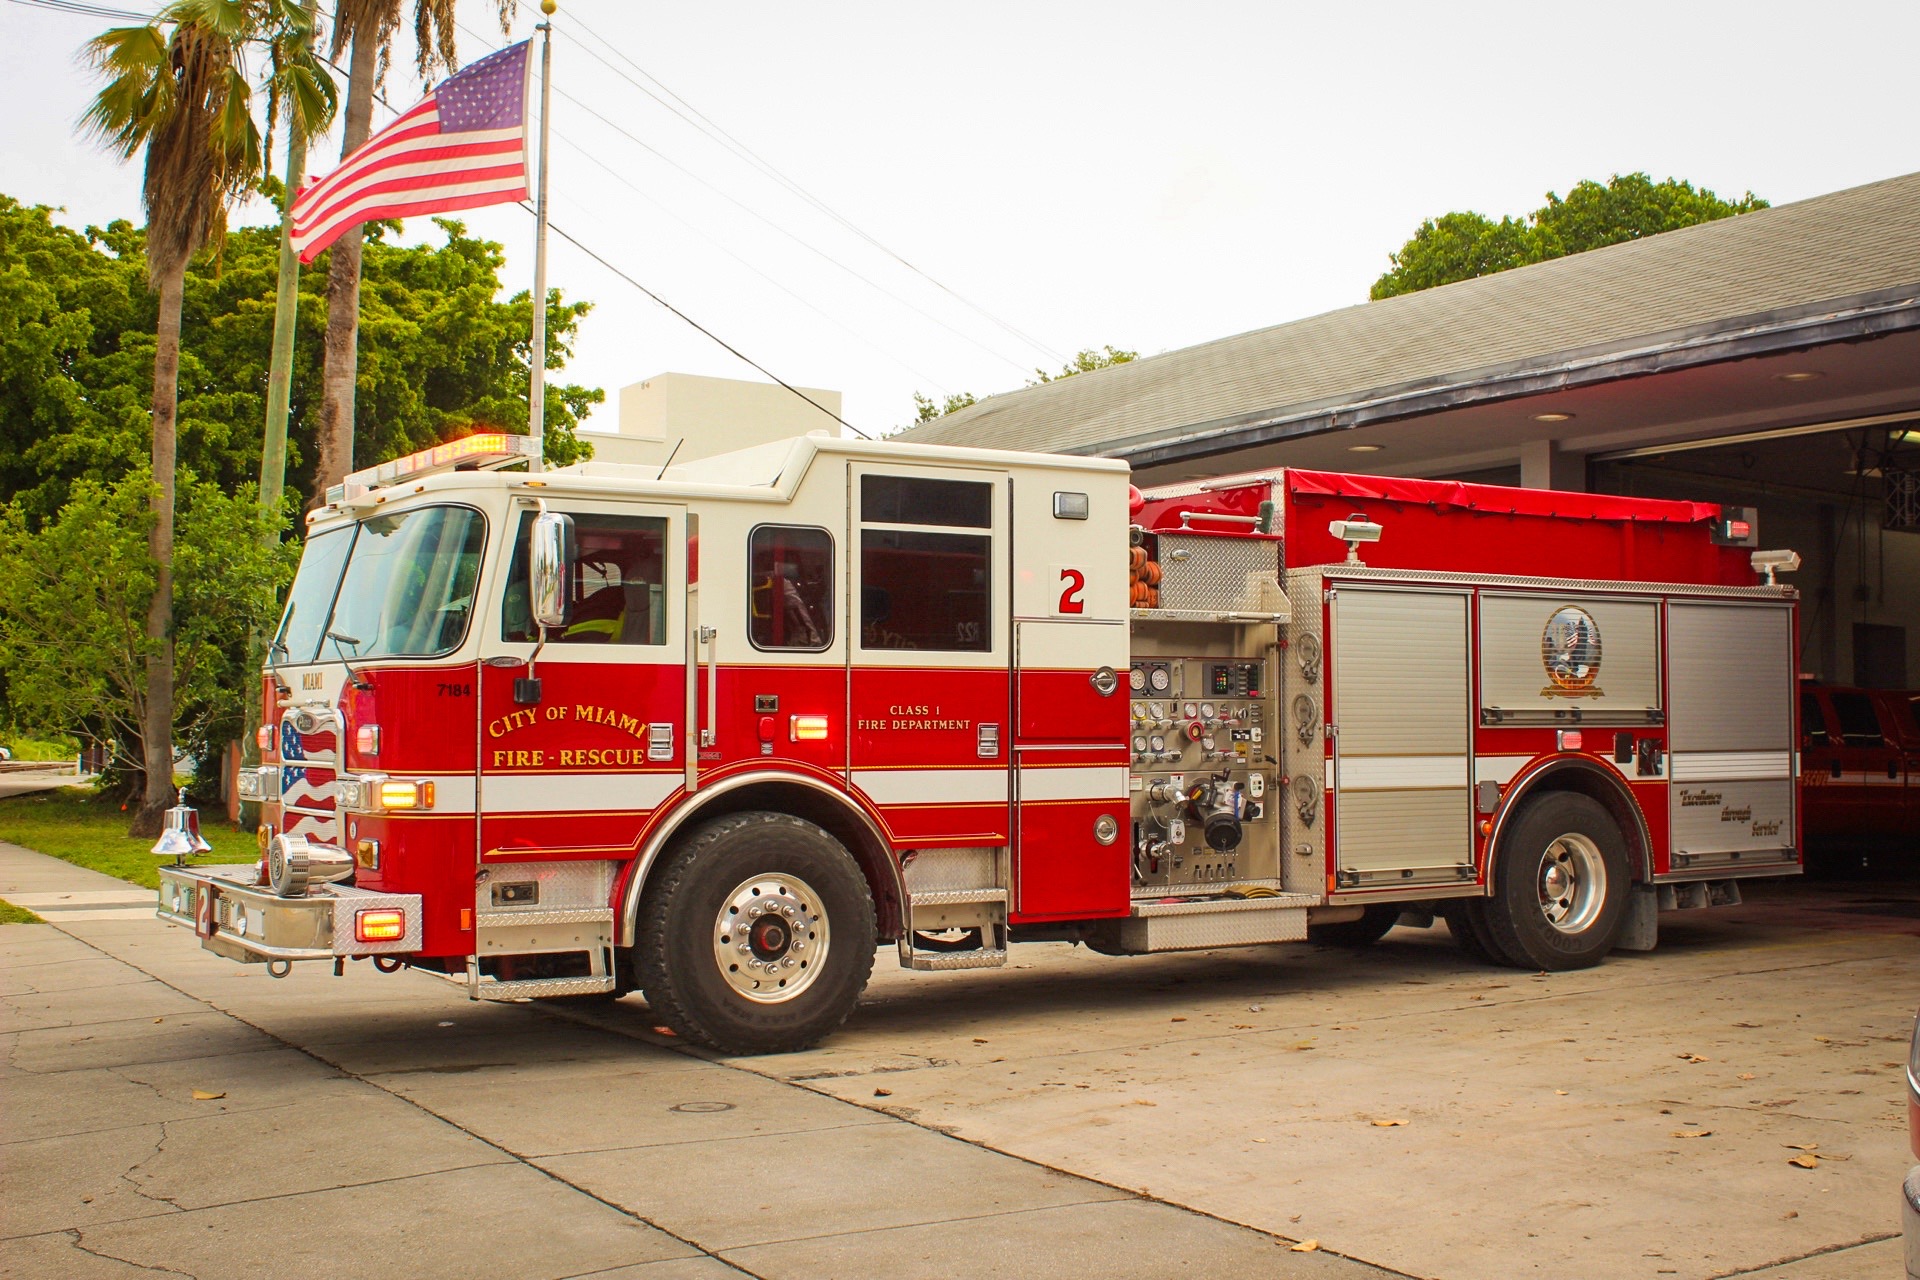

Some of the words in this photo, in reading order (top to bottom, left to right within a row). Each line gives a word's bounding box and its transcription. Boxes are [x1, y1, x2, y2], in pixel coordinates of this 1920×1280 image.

[1059, 569, 1084, 614] 2
[437, 684, 470, 696] 7184
[889, 705, 929, 715] CLASS
[489, 707, 537, 738] CITY
[546, 706, 568, 720] OF
[575, 705, 648, 739] MIAMI
[858, 720, 887, 730] FIRE
[892, 720, 970, 730] DEPARTMENT
[493, 750, 545, 767] FIRE
[559, 749, 645, 765] RESCUE
[199, 887, 208, 934] 2
